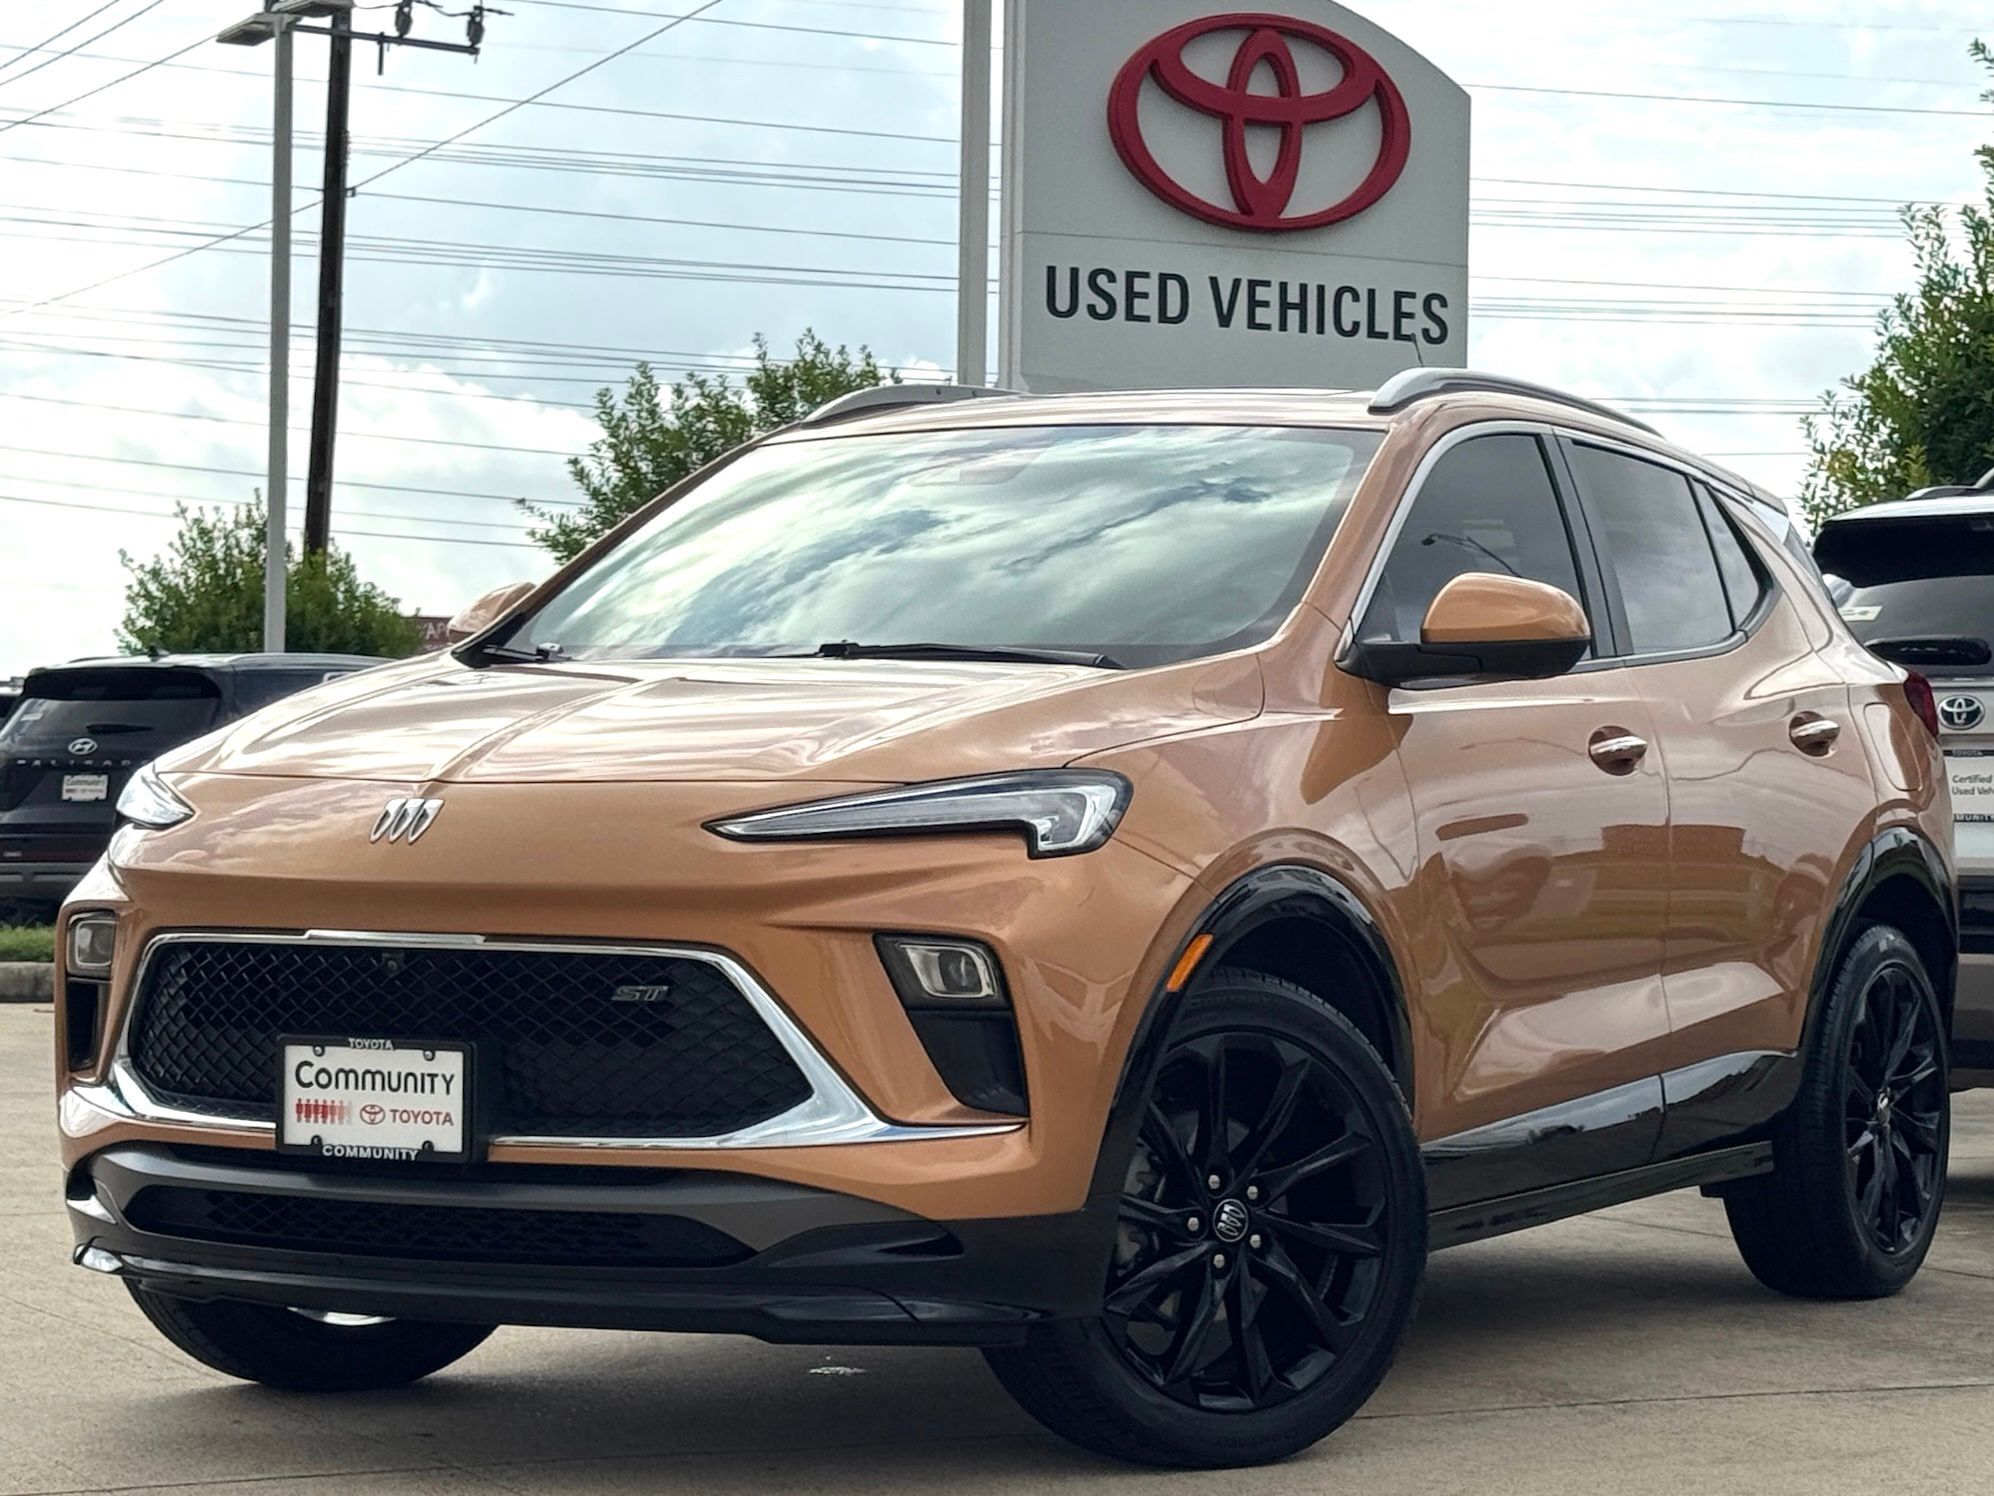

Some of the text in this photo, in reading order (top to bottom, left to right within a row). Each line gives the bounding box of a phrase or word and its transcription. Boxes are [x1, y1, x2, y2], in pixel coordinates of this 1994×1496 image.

[1046, 265, 1449, 346] USED VEHICLES
[1953, 748, 1984, 756] TOYOTA
[1952, 774, 1993, 784] Certified
[1952, 786, 1976, 796] Used
[611, 985, 669, 1001] ST
[348, 1038, 394, 1050] TOYOTA
[389, 1108, 455, 1126] TOYOTA
[322, 1144, 419, 1161] COMMUNITY
